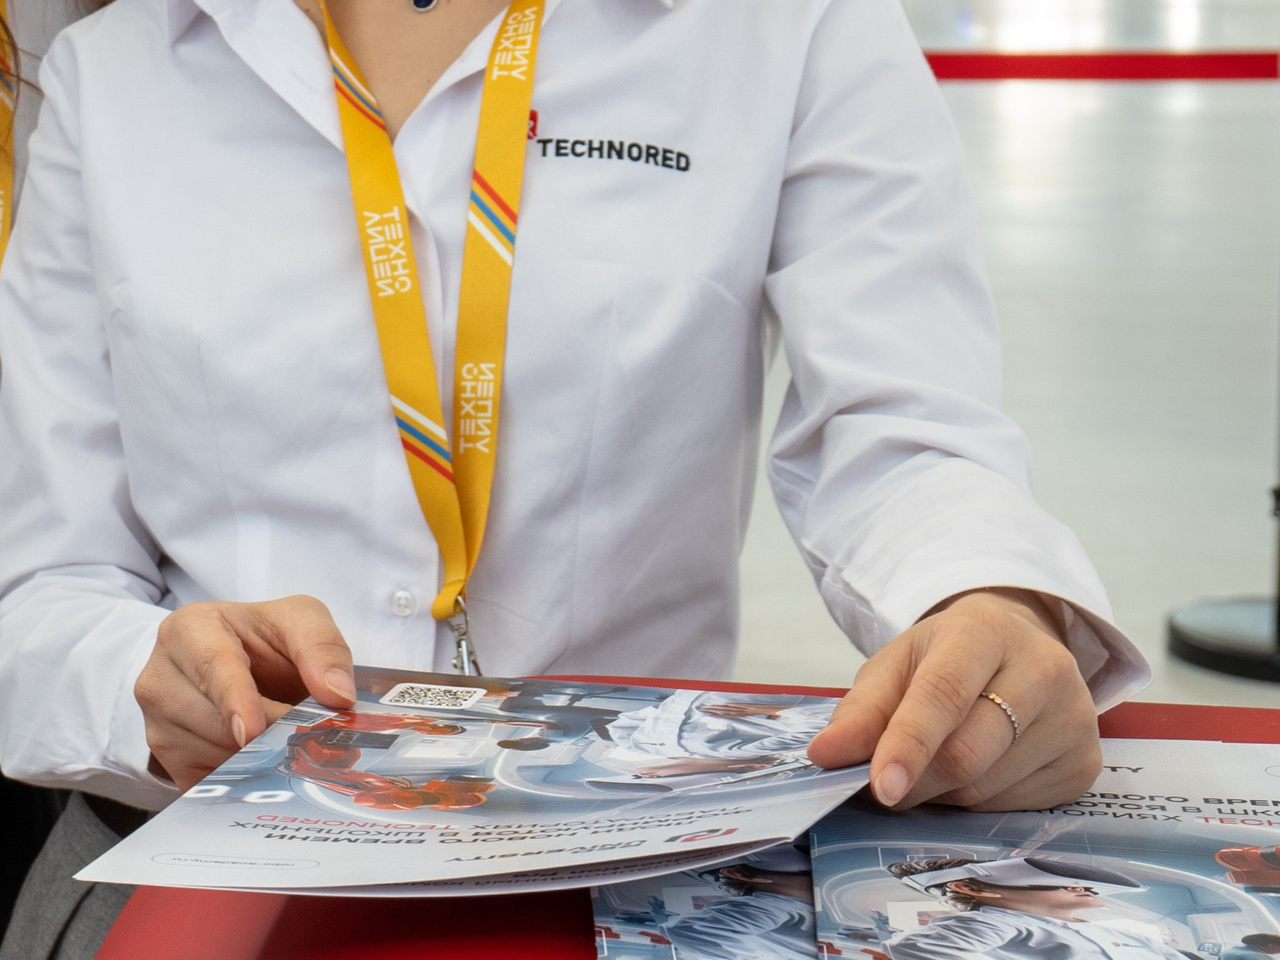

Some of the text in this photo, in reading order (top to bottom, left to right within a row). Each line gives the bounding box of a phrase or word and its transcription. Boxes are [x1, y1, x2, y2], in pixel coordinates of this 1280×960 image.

[537, 138, 691, 172] TECHNORED
[382, 206, 412, 293] ТЕХНО
[458, 363, 478, 454] ТЕХНО
[1078, 791, 1190, 803] ОВОГО
[229, 821, 425, 837] ШКОЛЬНЫХ
[256, 815, 454, 830] TECHNORED
[264, 833, 425, 844] ВРЕМЕНИ
[439, 832, 578, 844] НОВОГО
